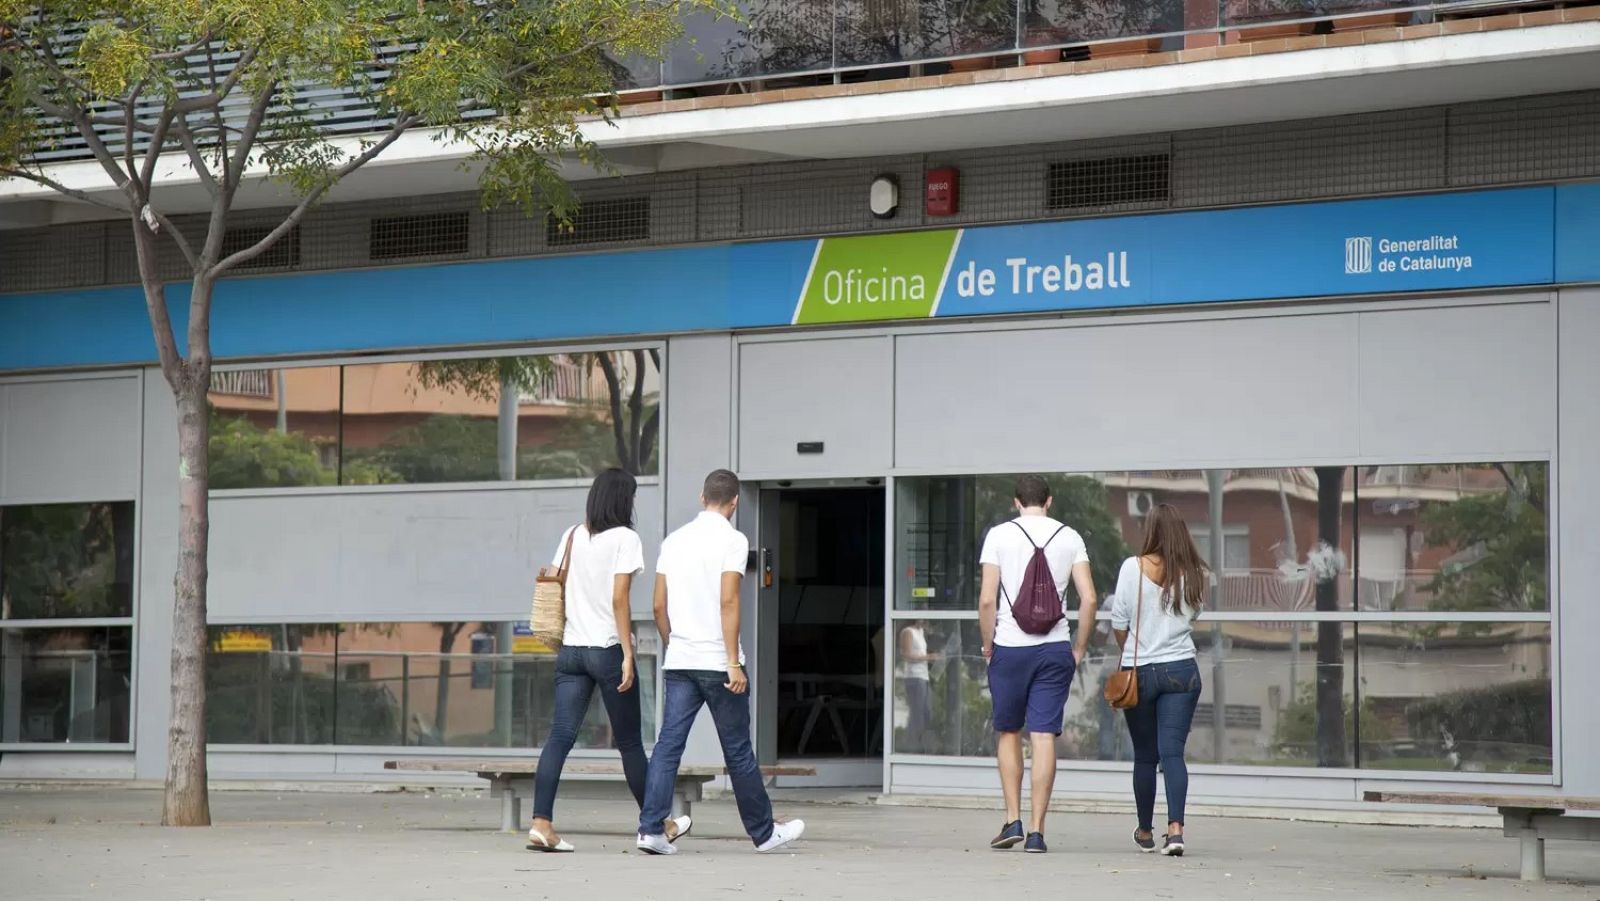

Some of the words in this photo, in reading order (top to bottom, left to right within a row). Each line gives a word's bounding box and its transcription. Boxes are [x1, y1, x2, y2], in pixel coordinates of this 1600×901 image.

[928, 182, 948, 191] FUEGO
[1379, 235, 1458, 253] Generalitat
[1378, 258, 1396, 272] de
[1400, 255, 1472, 272] Catalunya
[823, 266, 925, 305] Oficina
[957, 261, 996, 297] de
[1006, 251, 1131, 294] Treball
